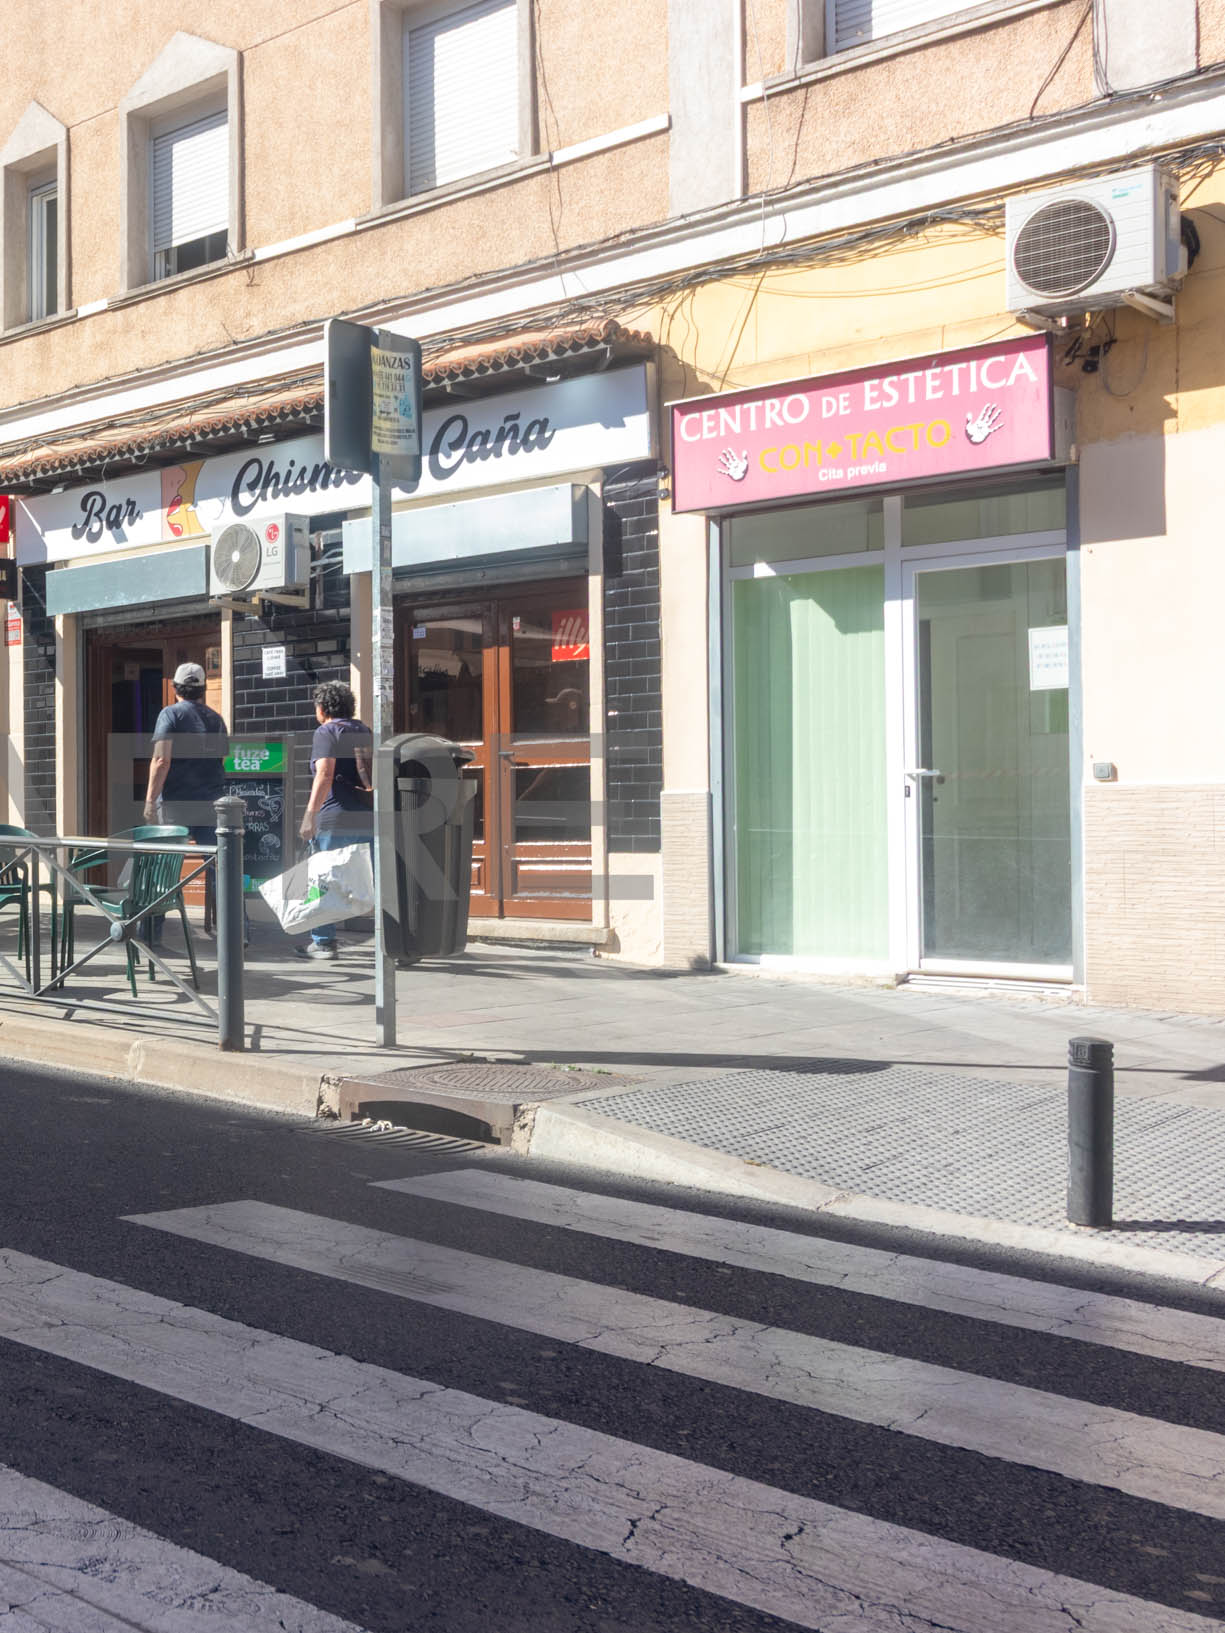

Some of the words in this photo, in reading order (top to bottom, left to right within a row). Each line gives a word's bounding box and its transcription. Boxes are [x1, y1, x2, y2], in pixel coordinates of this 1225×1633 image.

[680, 393, 810, 442] CENTRO
[821, 392, 850, 419] DE
[863, 352, 1039, 411] ESTÉTICA
[71, 490, 141, 544] Bar
[428, 411, 557, 481] Caña
[818, 466, 844, 481] Cita
[847, 461, 888, 480] previa
[266, 546, 279, 558] LG
[555, 617, 589, 656] illy
[233, 744, 270, 760] fuze
[233, 759, 261, 770] tea
